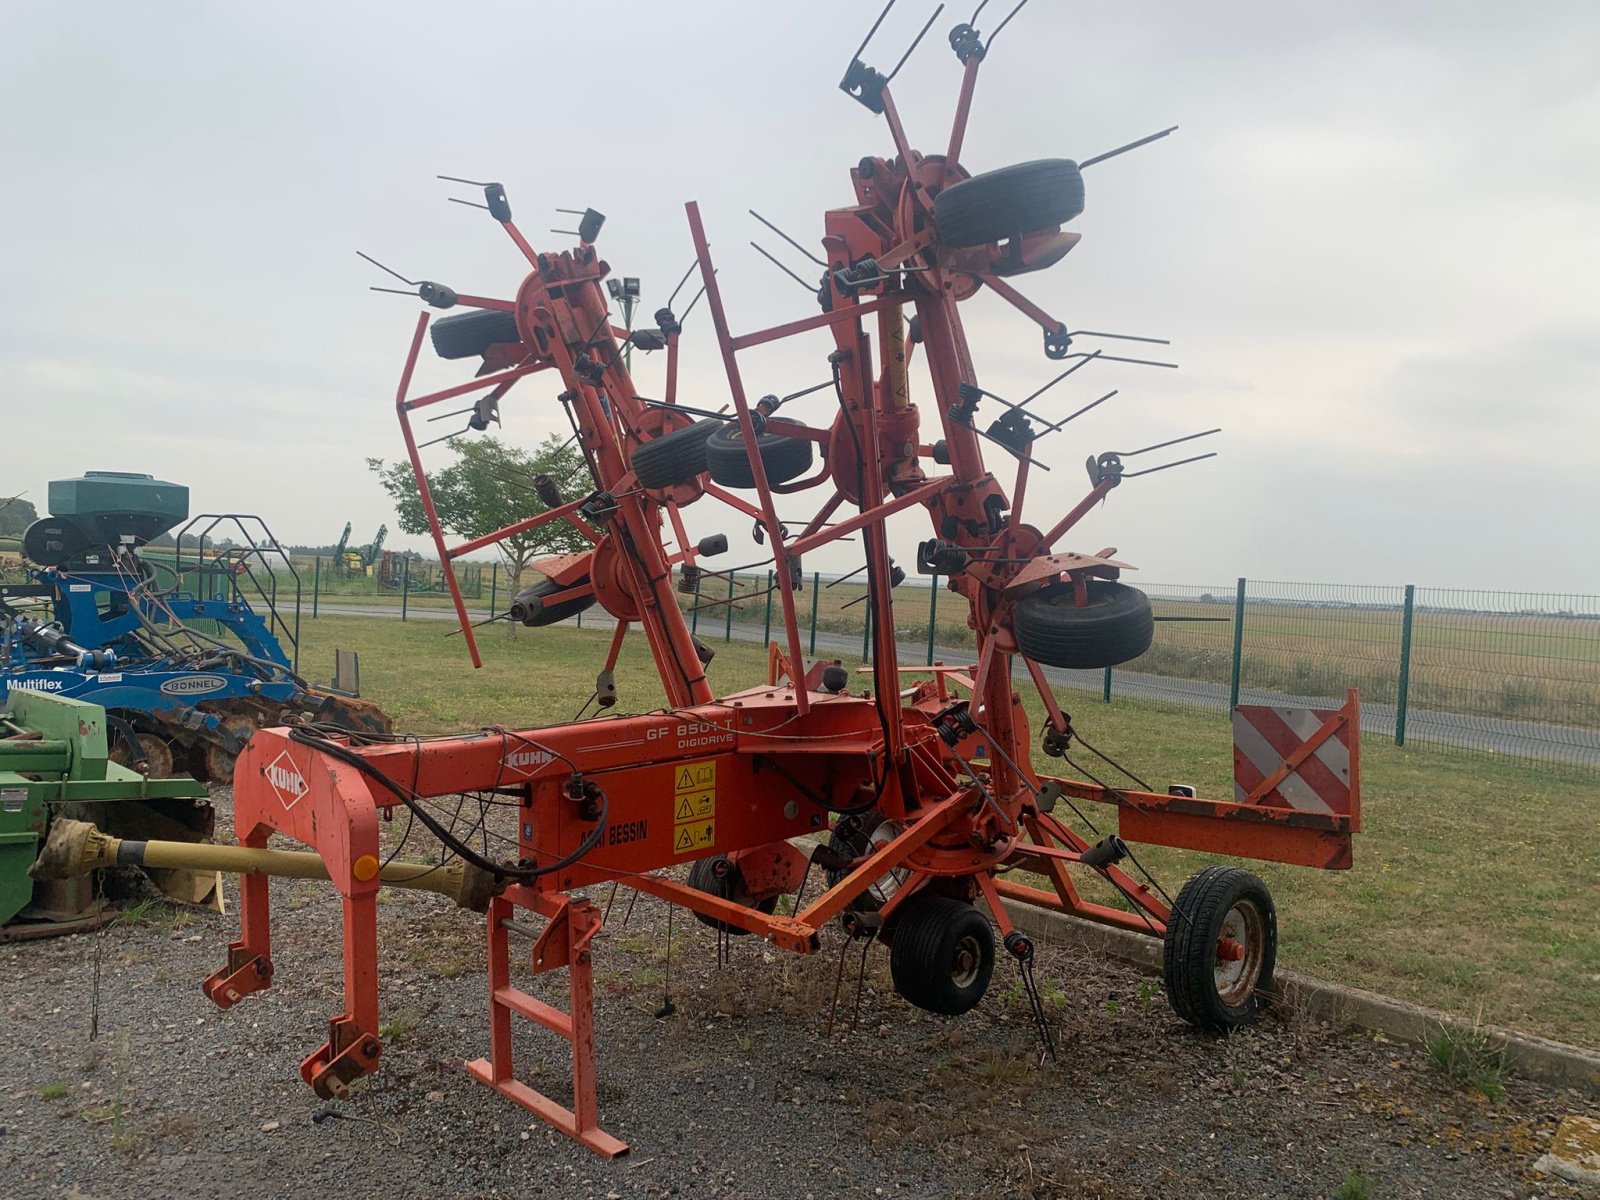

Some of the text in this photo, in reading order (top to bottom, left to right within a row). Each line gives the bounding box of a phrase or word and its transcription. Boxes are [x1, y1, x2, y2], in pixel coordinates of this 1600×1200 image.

[6, 679, 63, 691] Multiflex
[171, 680, 218, 691] BONNEL
[646, 727, 669, 740] GF
[725, 719, 733, 731] T
[678, 733, 734, 749] DIGIDRIVE
[507, 751, 553, 768] KUHN
[271, 765, 303, 797] KUHN
[609, 820, 647, 846] BESSIN
